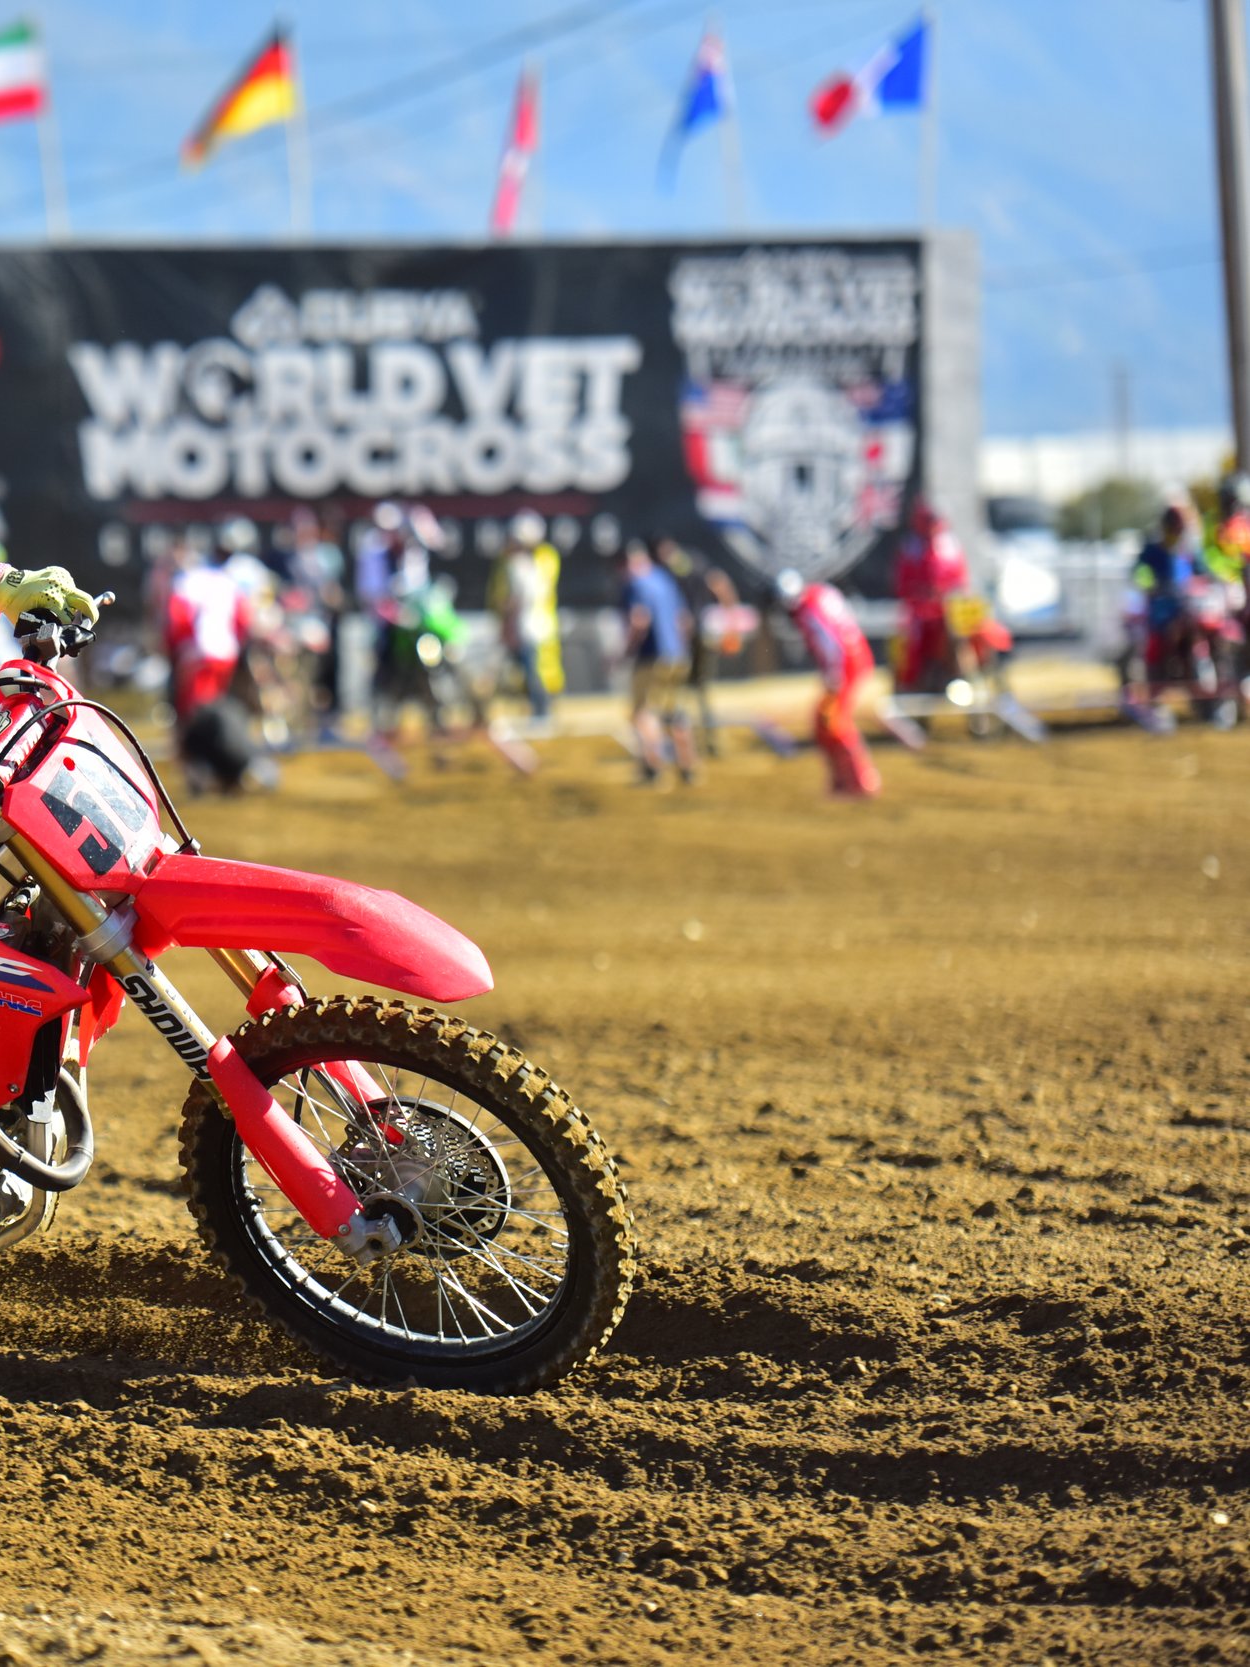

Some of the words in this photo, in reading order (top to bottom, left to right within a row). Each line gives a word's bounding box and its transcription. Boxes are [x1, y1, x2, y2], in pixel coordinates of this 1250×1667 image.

[70, 338, 442, 426] WORLD
[448, 336, 640, 426] VET
[80, 420, 632, 499] MOTOCROSS
[114, 973, 213, 1081] SHOWA
